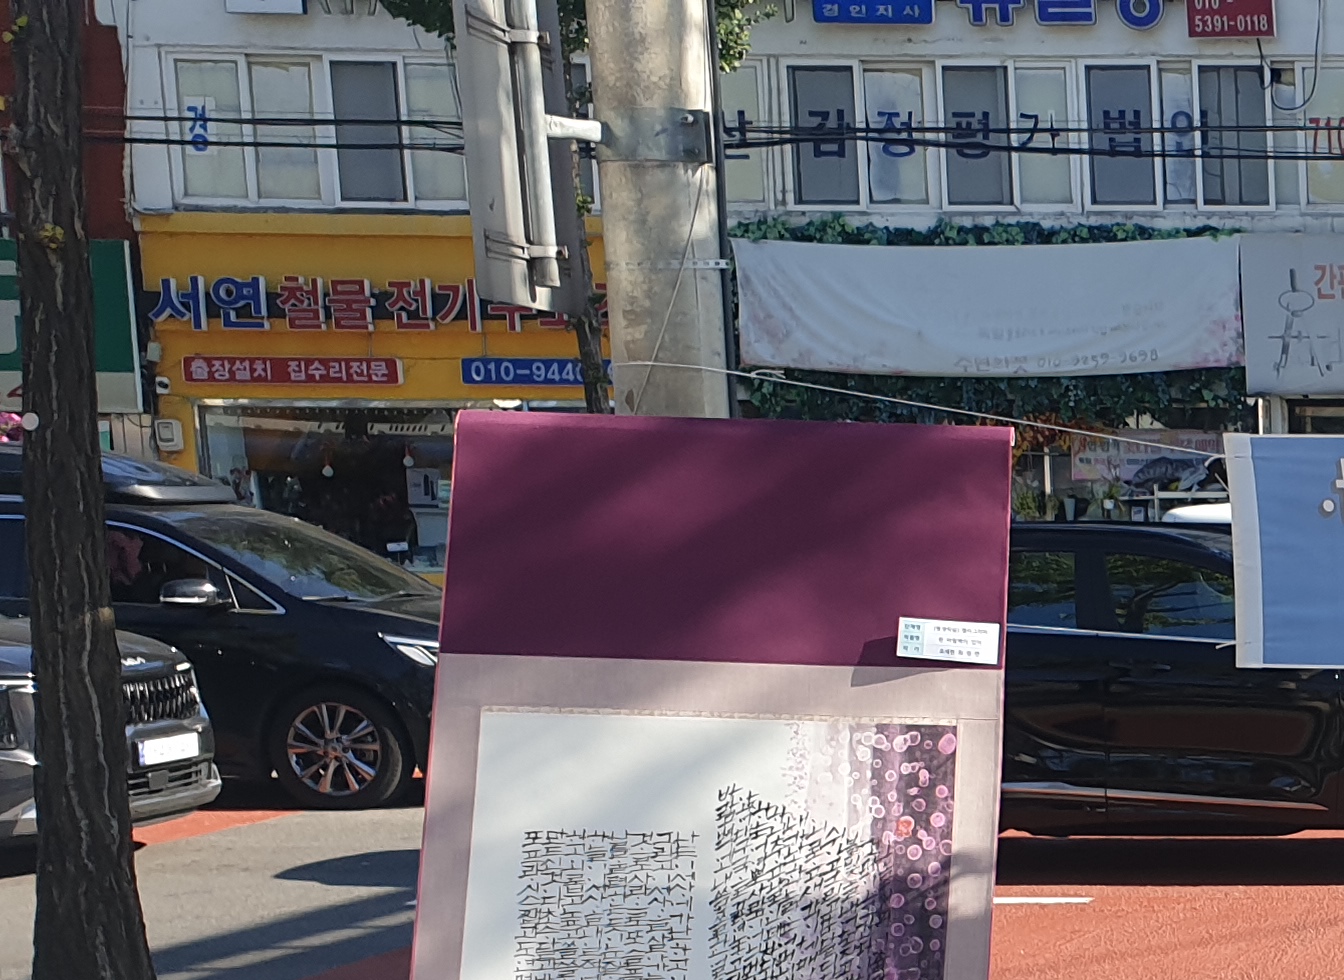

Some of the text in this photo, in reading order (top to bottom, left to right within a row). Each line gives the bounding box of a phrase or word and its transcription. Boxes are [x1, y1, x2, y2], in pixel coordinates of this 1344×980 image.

[1194, 14, 1269, 33] 5391-0118
[149, 276, 270, 331] 서연
[277, 276, 377, 331] 철물
[190, 359, 389, 381] 출장설치 집수리전문
